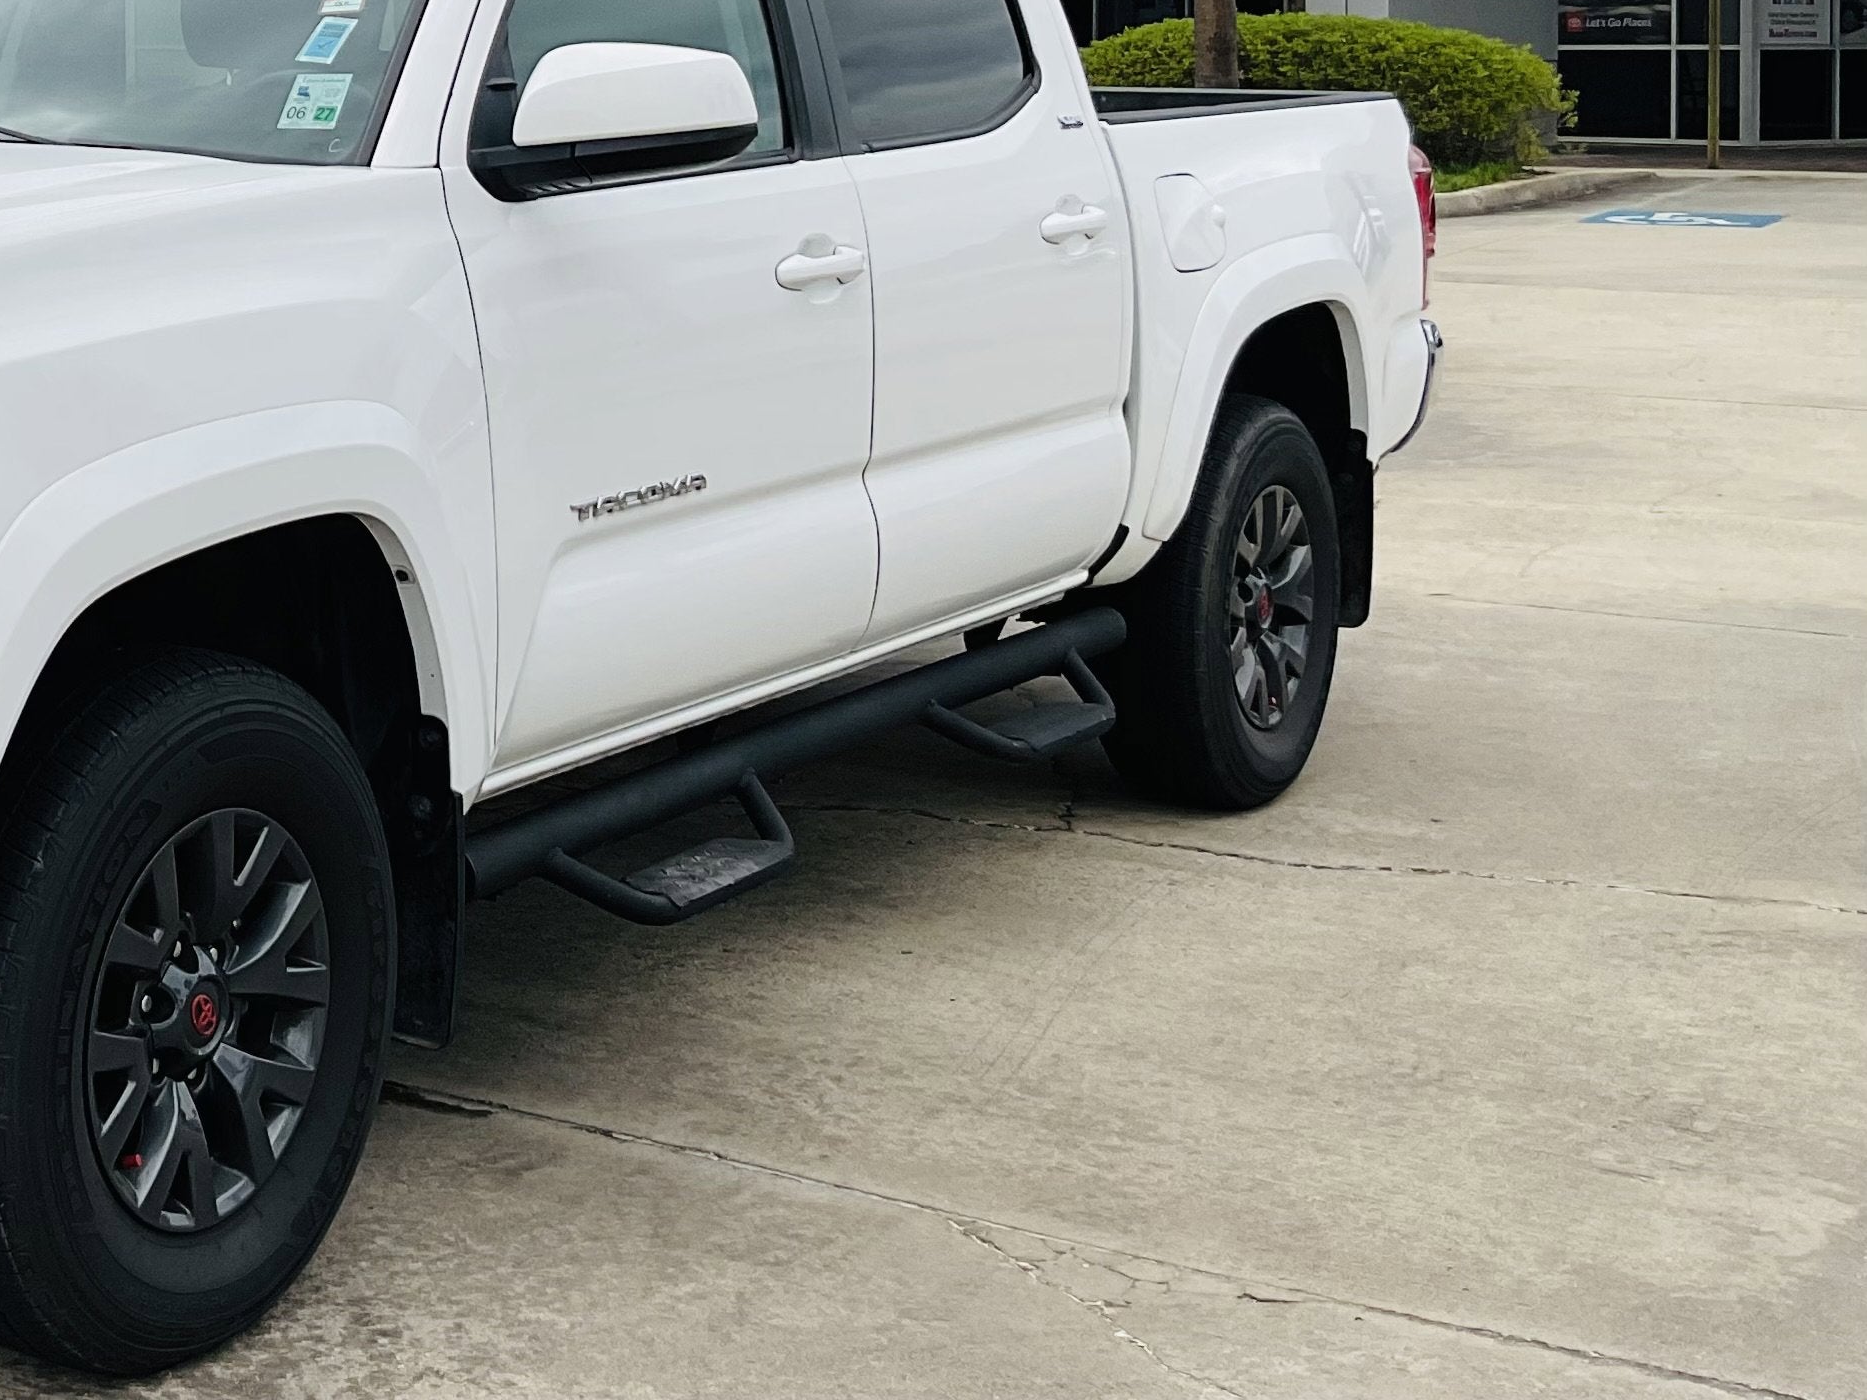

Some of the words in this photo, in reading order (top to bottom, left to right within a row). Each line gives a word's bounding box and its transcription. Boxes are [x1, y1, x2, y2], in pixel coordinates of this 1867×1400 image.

[1608, 17, 1621, 27] Go
[286, 106, 307, 120] 06
[314, 106, 334, 120] 27
[569, 472, 708, 522] TACOMA
